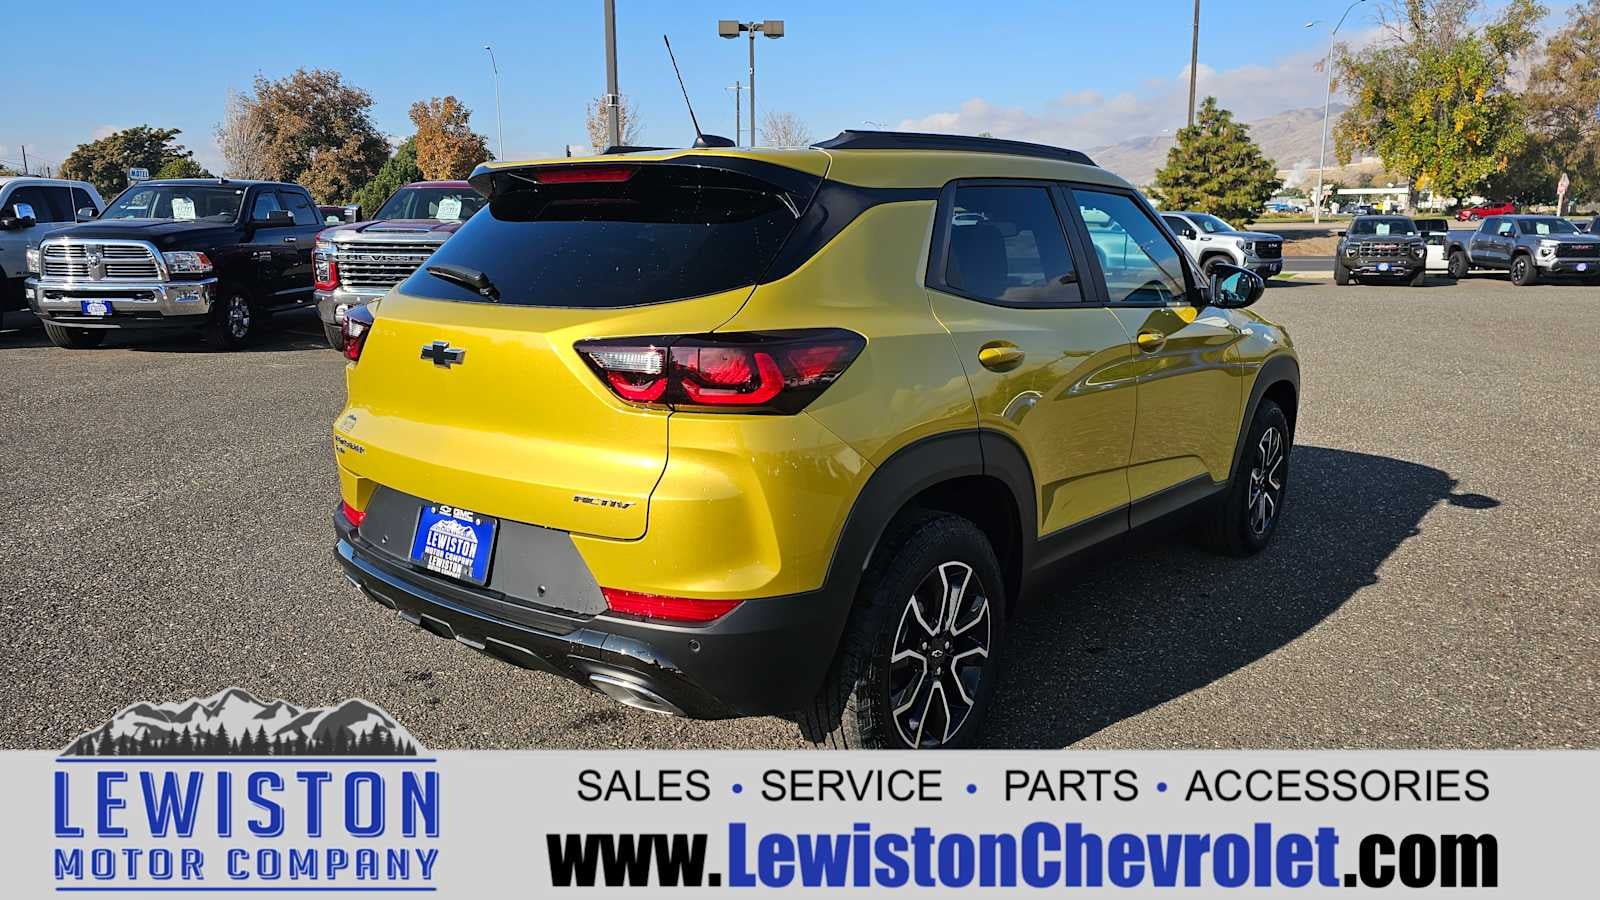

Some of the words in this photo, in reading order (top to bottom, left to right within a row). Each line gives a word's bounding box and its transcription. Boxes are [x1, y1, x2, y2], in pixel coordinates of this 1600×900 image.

[131, 170, 149, 178] MOTEL
[453, 508, 474, 520] GMC
[427, 531, 478, 559] LEWISTON
[425, 546, 445, 559] MOTOR
[445, 552, 474, 567] COMPANY
[428, 556, 463, 574] LEWISTON
